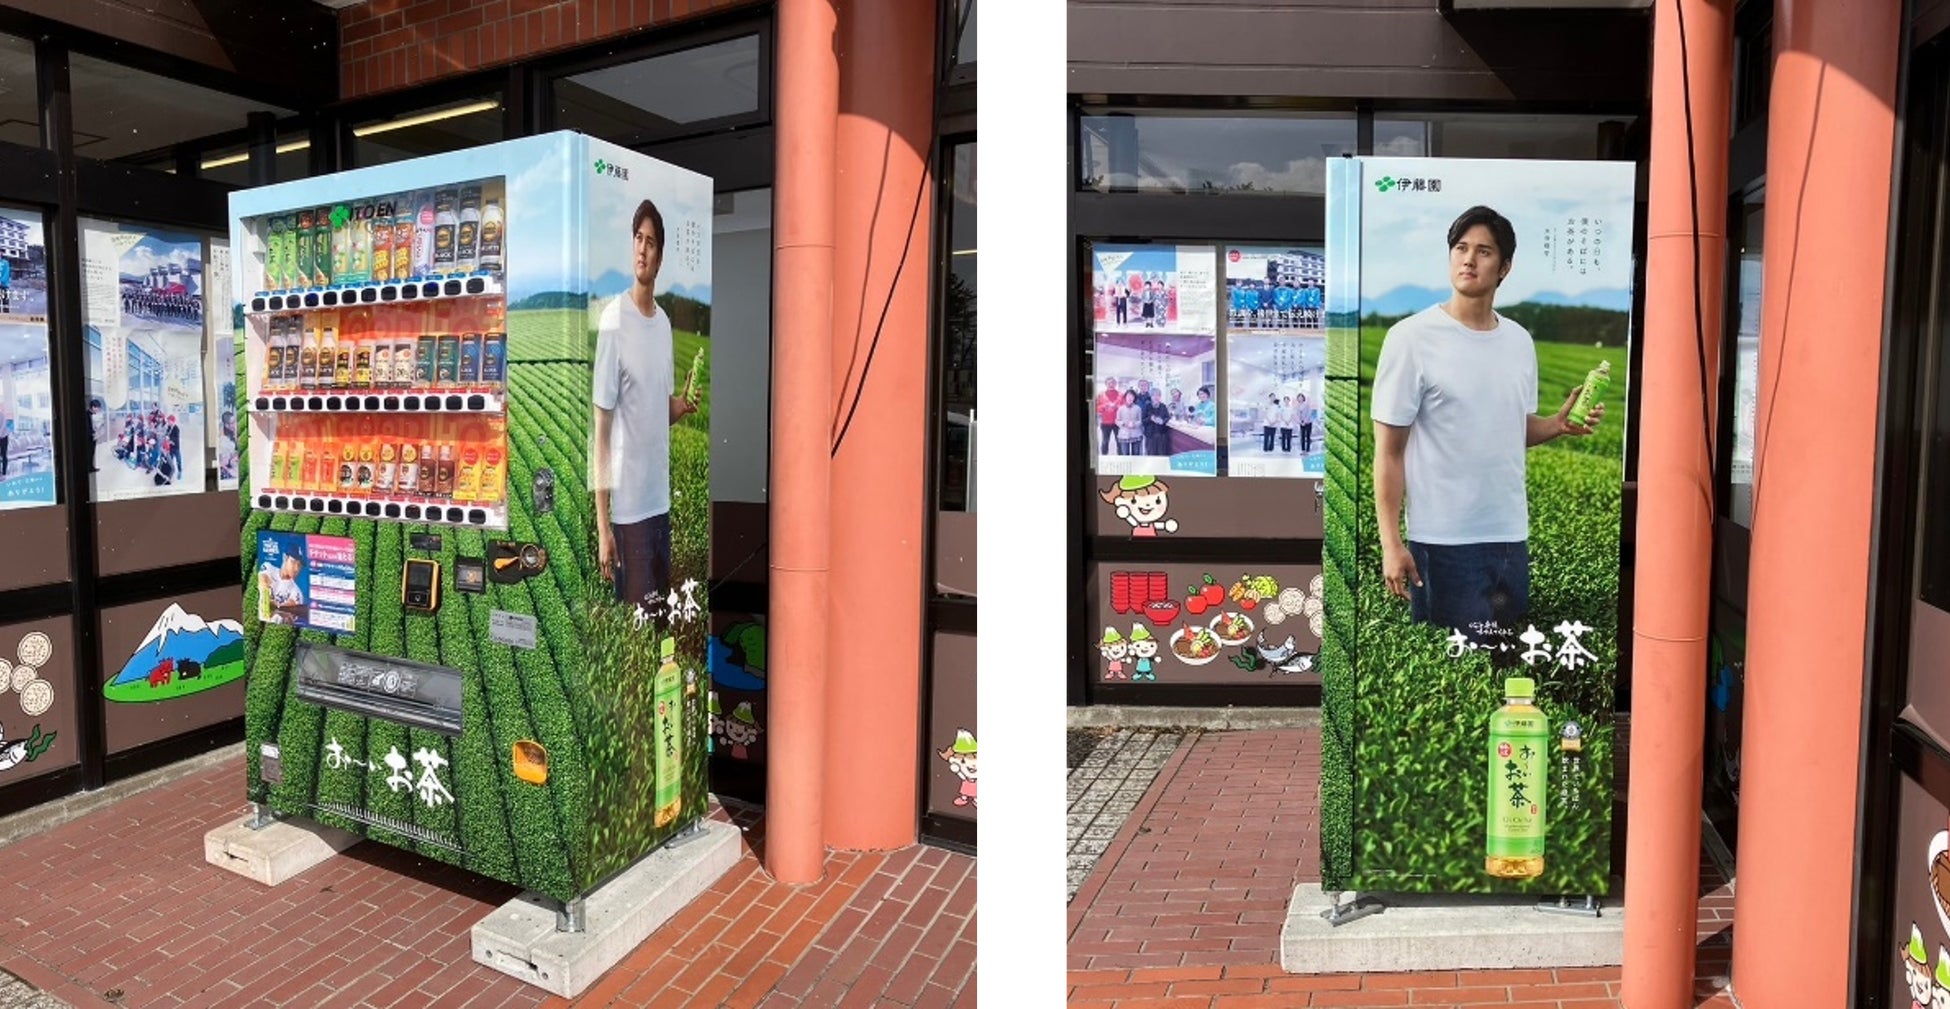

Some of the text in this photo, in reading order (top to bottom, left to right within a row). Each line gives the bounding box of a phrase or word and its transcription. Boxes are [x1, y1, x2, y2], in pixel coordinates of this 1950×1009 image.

[606, 163, 630, 181] 伊藤園
[1396, 177, 1442, 193] 伊藤園
[349, 201, 398, 222] ITO EN
[1566, 217, 1576, 270] お茶がある。
[1593, 218, 1603, 272] いつの日も、
